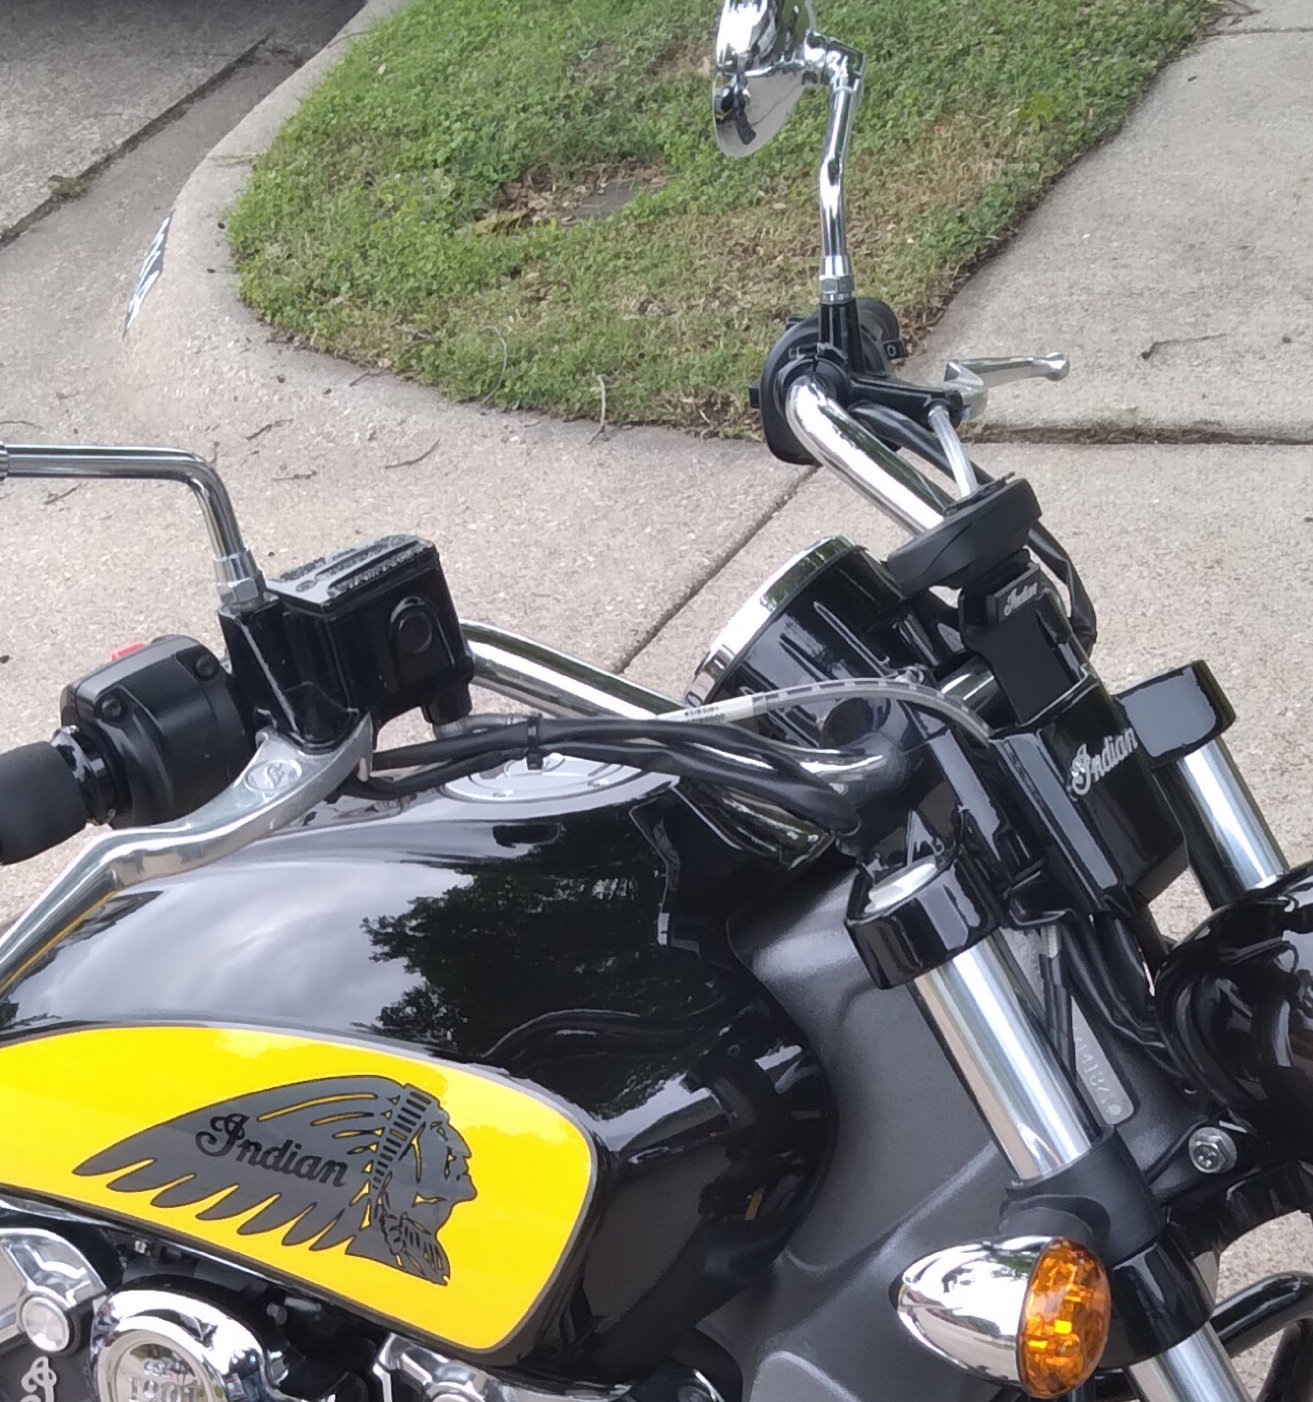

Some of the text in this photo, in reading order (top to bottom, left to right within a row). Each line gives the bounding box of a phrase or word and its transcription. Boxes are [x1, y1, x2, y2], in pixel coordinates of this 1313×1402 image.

[1003, 582, 1038, 617] Indian
[1071, 727, 1138, 796] Indian
[195, 1113, 348, 1187] Indian
